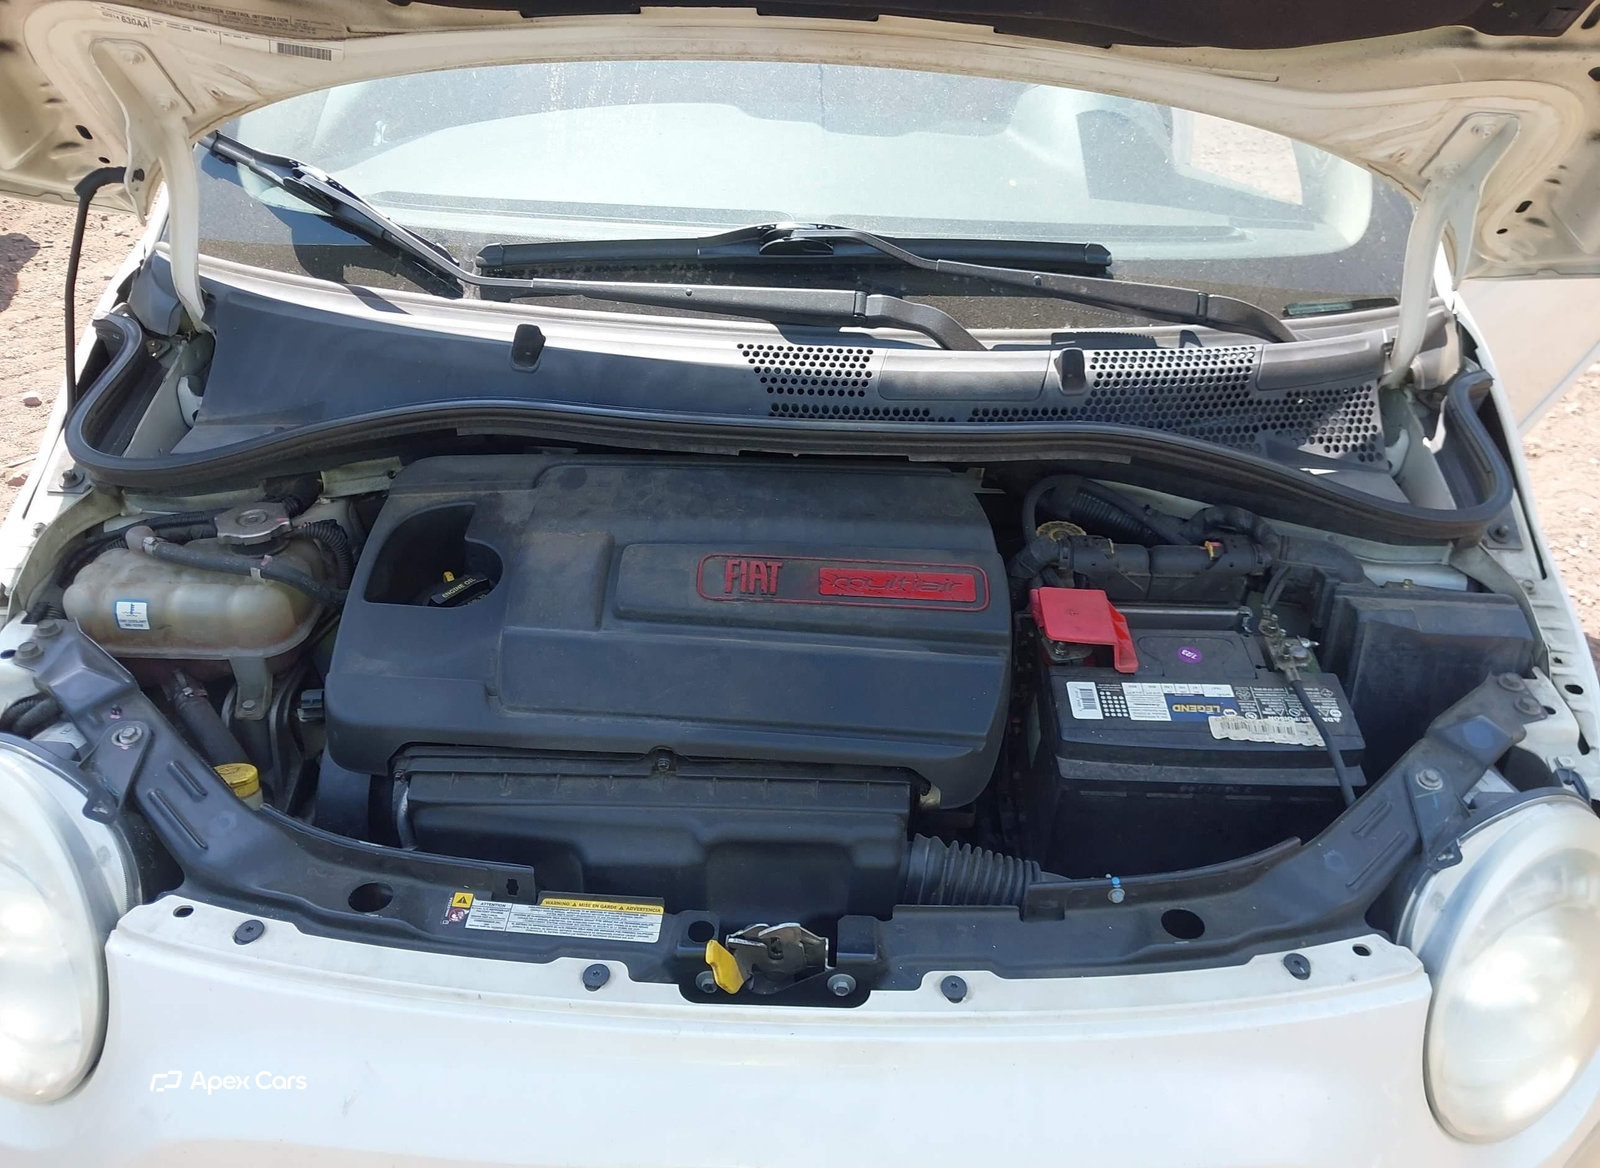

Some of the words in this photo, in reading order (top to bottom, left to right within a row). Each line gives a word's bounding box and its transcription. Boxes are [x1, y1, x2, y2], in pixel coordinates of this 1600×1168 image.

[121, 16, 149, 29] 630AA
[197, 4, 224, 14] EMISSION
[225, 9, 250, 19] CONTROL
[252, 13, 289, 23] INFORMATION
[724, 559, 783, 596] FIAT
[832, 573, 963, 593] multiair
[441, 583, 466, 599] ENGINE
[464, 577, 477, 587] OIL
[1172, 704, 1220, 713] LEGEND
